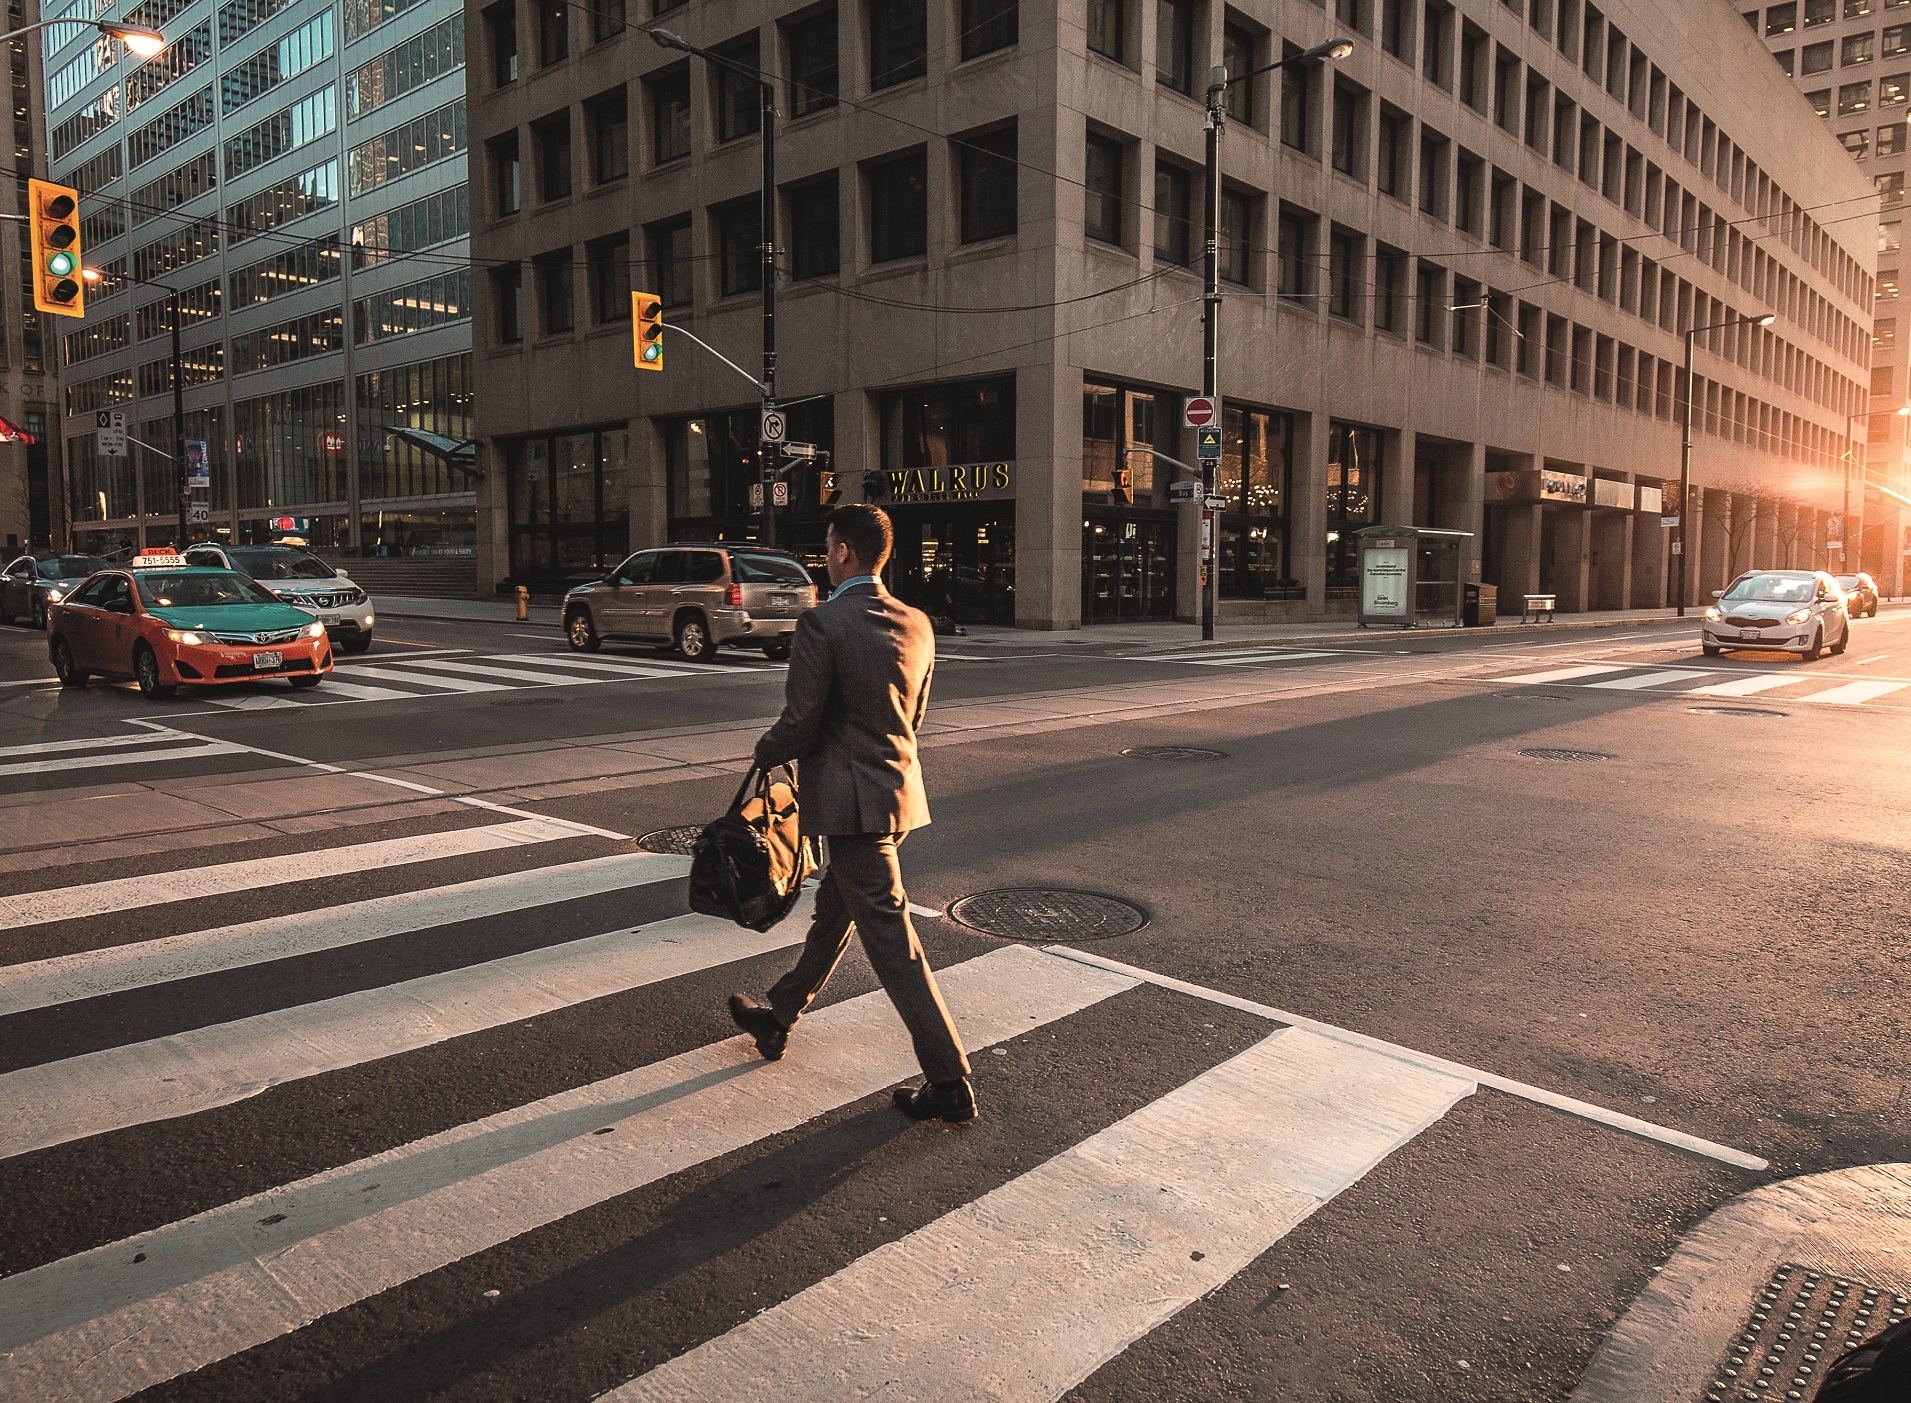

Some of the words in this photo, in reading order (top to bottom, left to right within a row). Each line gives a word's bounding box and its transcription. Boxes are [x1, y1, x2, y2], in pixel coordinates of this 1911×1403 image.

[21, 384, 45, 396] OF
[200, 440, 208, 464] CONNECT
[886, 463, 1009, 494] WALRUS
[924, 492, 950, 501] BEER
[952, 491, 980, 499] HALL
[193, 510, 207, 520] 40
[142, 556, 180, 564] 751-5555
